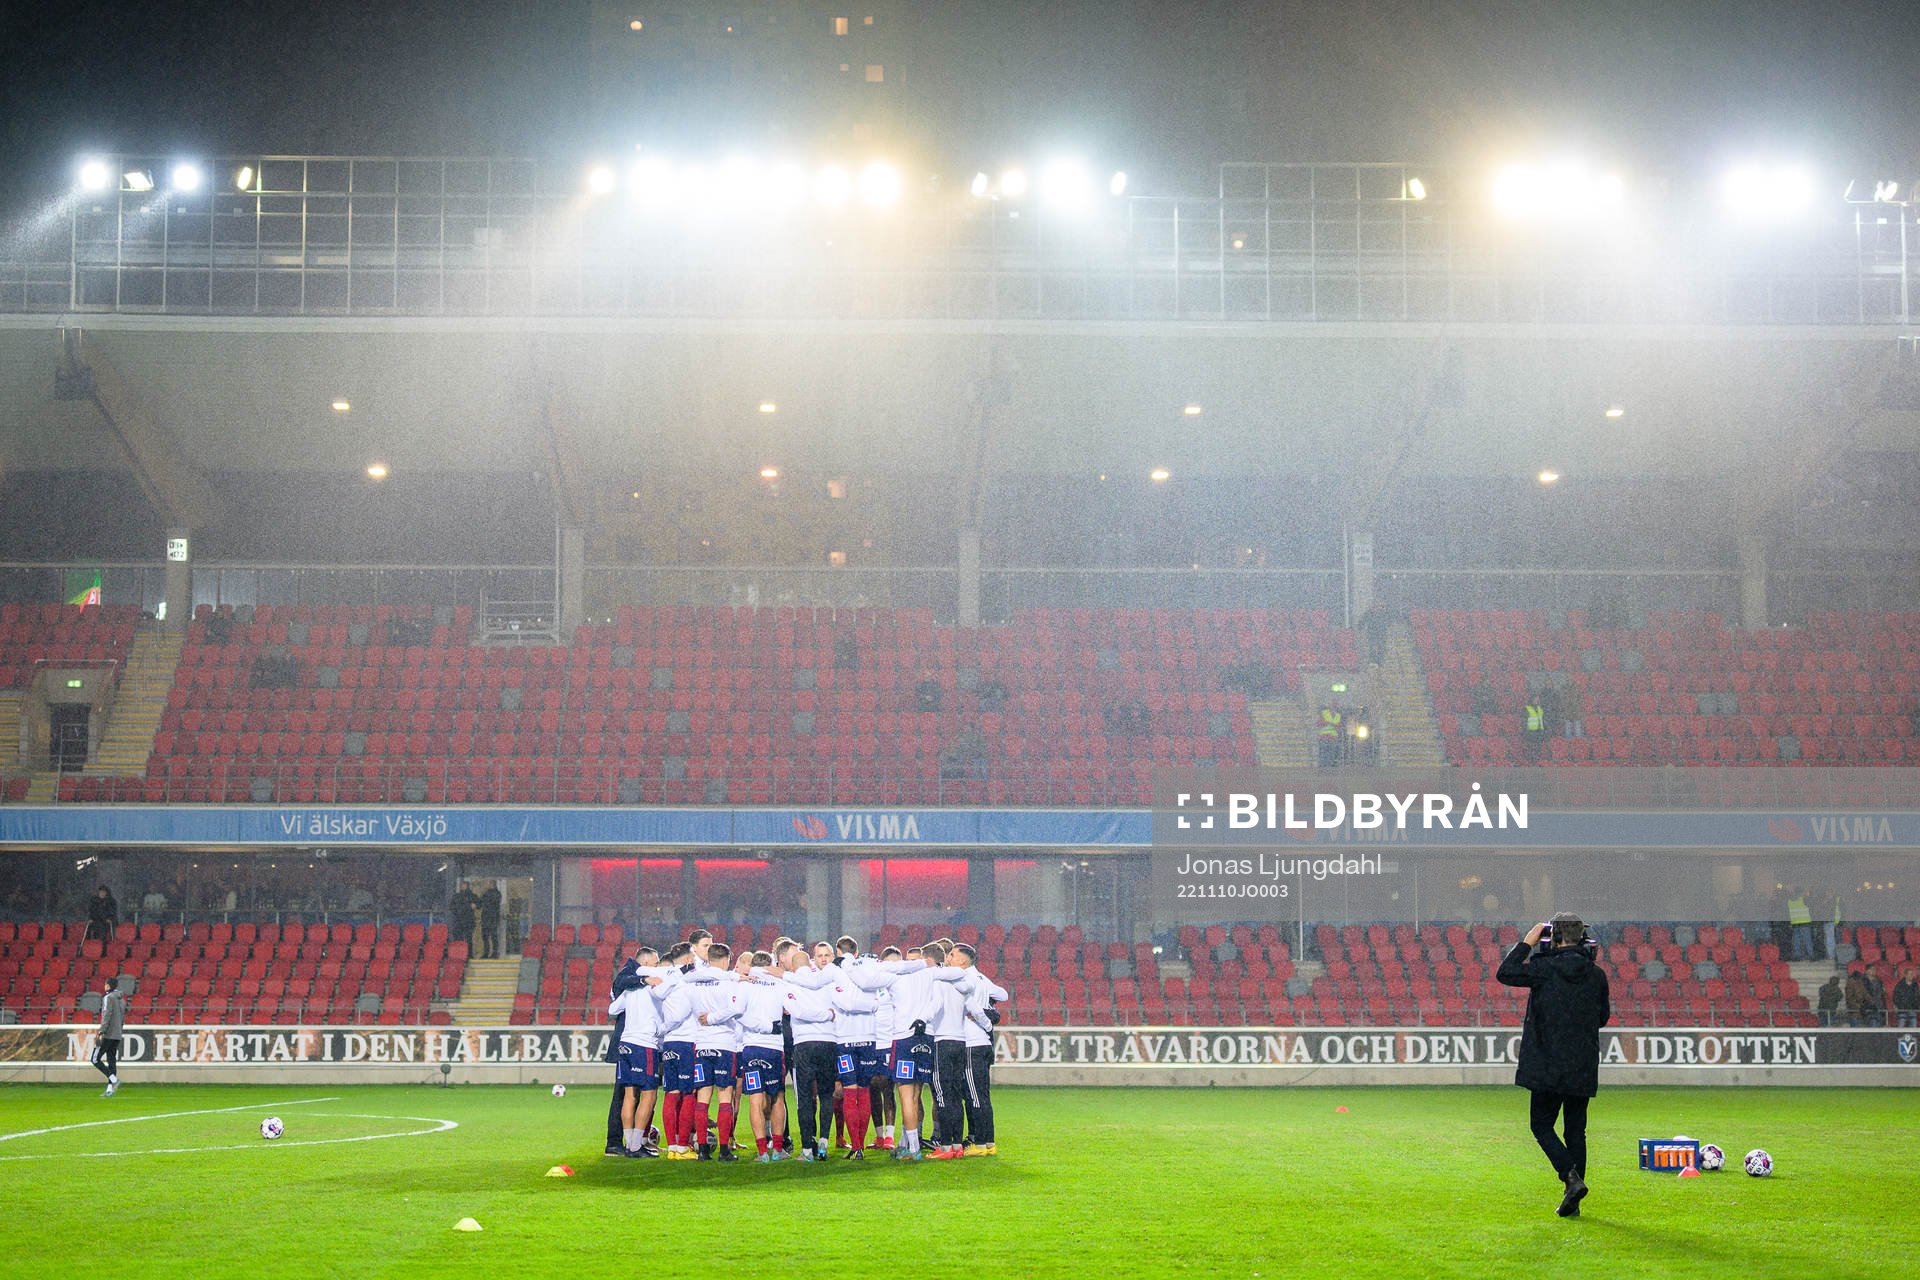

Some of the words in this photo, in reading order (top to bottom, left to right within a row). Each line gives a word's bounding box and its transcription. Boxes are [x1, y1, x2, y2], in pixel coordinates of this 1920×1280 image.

[280, 815, 302, 835] Vi
[309, 814, 379, 835] älskar
[386, 815, 448, 841] Växjö
[836, 814, 921, 840] VISMA
[1811, 816, 1894, 842] VISMA
[66, 1033, 146, 1062] MD
[154, 1028, 313, 1062] HJÄRTAT
[322, 1033, 334, 1062] I
[343, 1033, 417, 1062] DEN
[425, 1029, 611, 1062] HÅLLBARA
[1070, 1030, 1313, 1064] TRÄVARORNA
[1320, 1035, 1396, 1064] OCH
[1403, 1035, 1476, 1064] DEN
[1635, 1035, 1818, 1064] IDROTTEN
